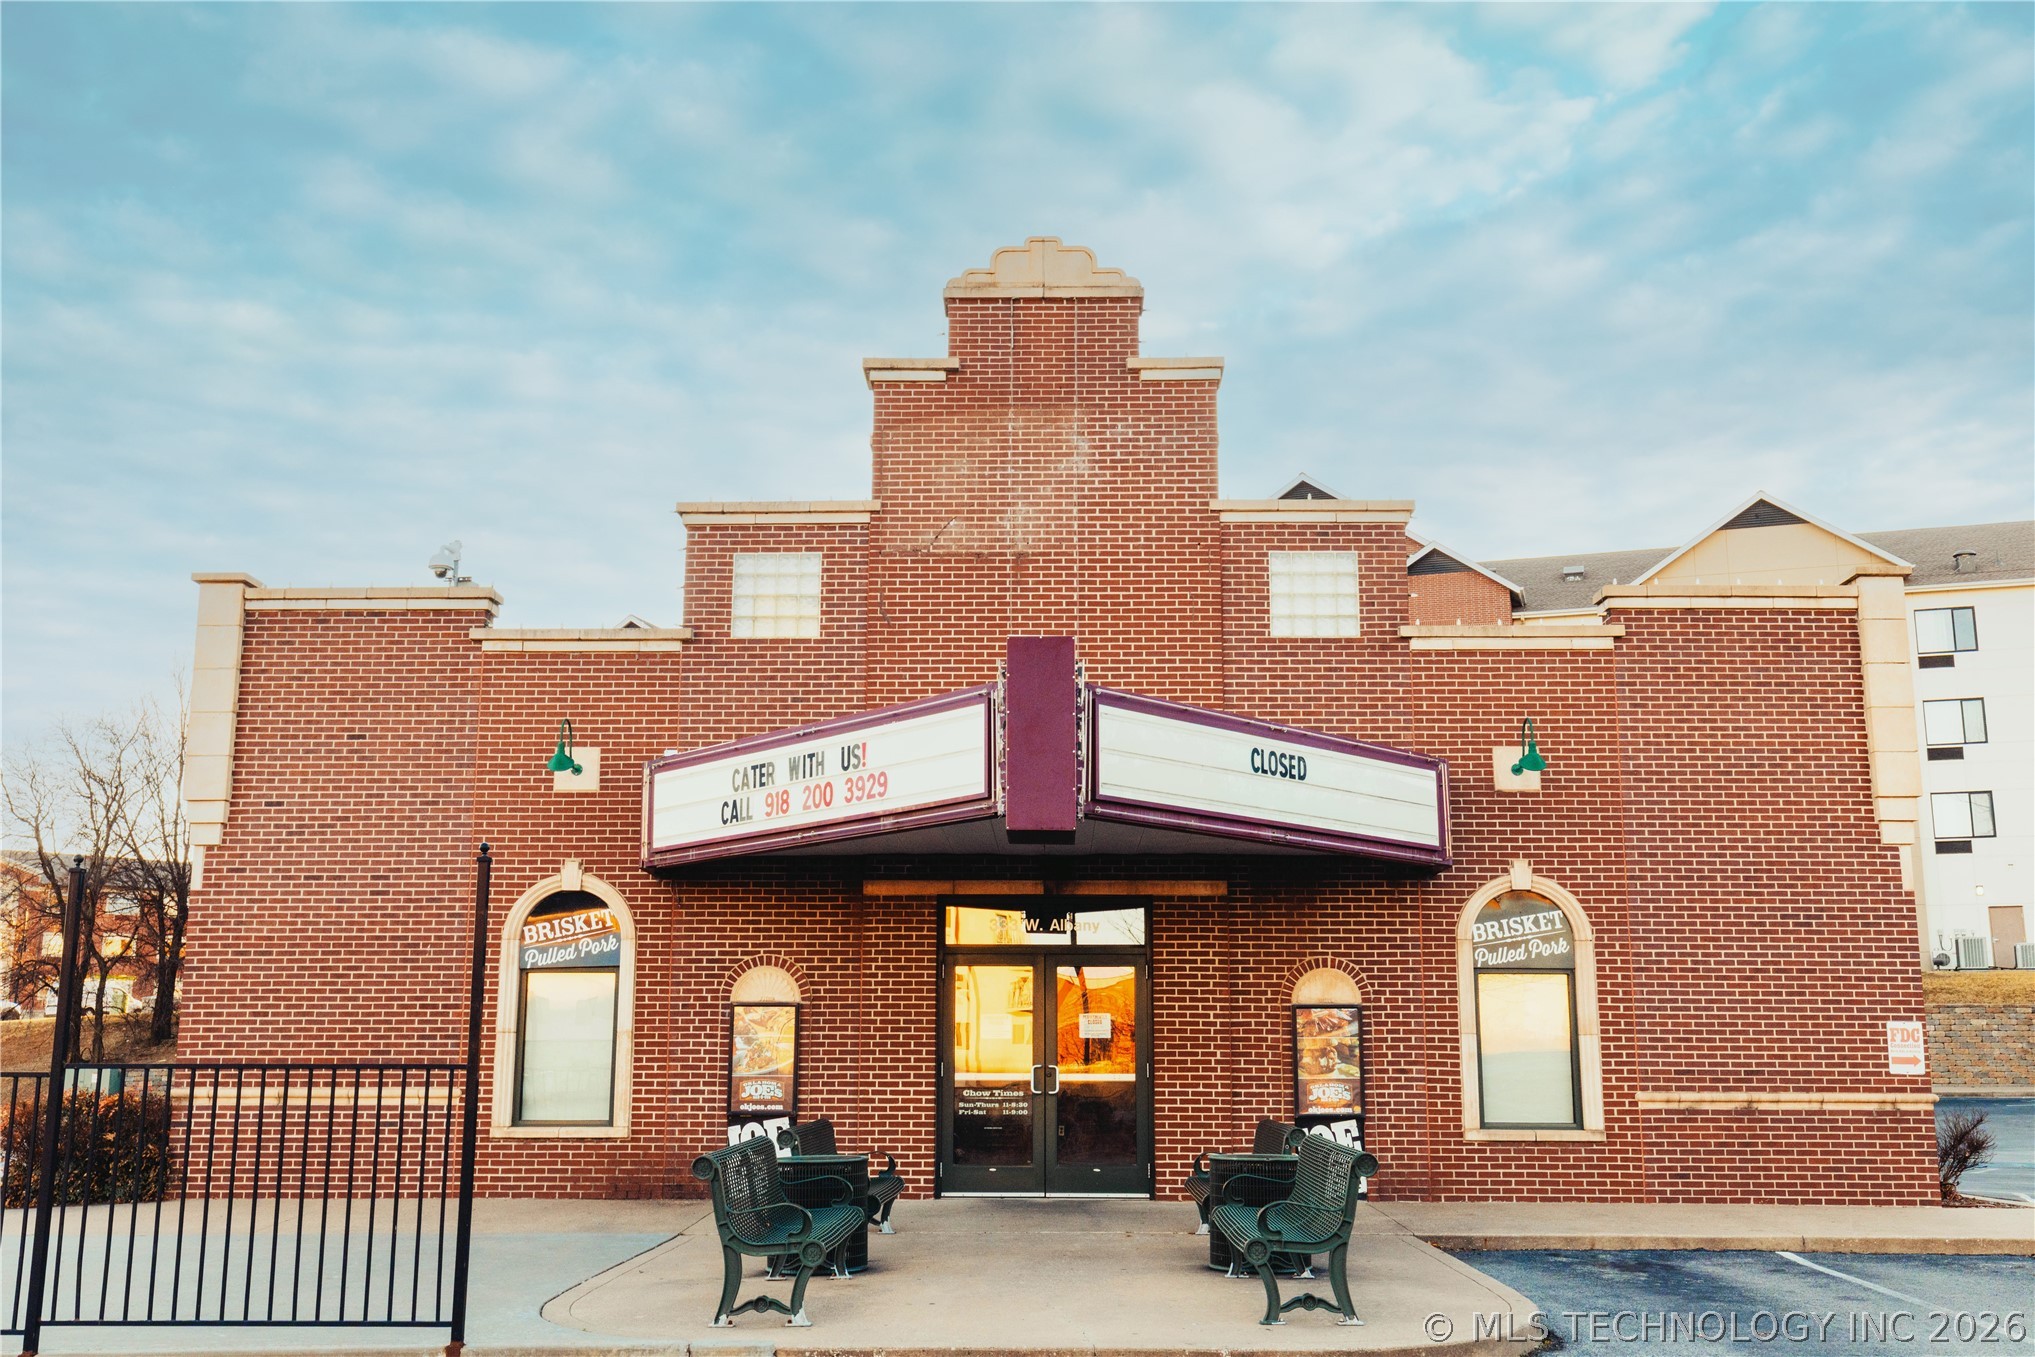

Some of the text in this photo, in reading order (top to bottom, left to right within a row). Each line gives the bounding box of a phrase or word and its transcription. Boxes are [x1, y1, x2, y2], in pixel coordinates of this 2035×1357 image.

[732, 742, 867, 792] CATER WITH US!
[1251, 747, 1307, 781] CLOSED
[721, 771, 888, 825] CALL 918 200 3929
[523, 908, 615, 945] BRISKET
[1025, 918, 1044, 931] W.
[1049, 918, 1100, 934] Albany
[1472, 910, 1564, 942] BRISKET
[524, 935, 620, 969] Pulled Pork
[1474, 937, 1570, 968] Pulled Pork
[1889, 1027, 1921, 1043] FDC
[740, 1103, 784, 1111] okjoes.com
[962, 1089, 1025, 1097] Chow Times
[1308, 1105, 1353, 1113] okjoes.com
